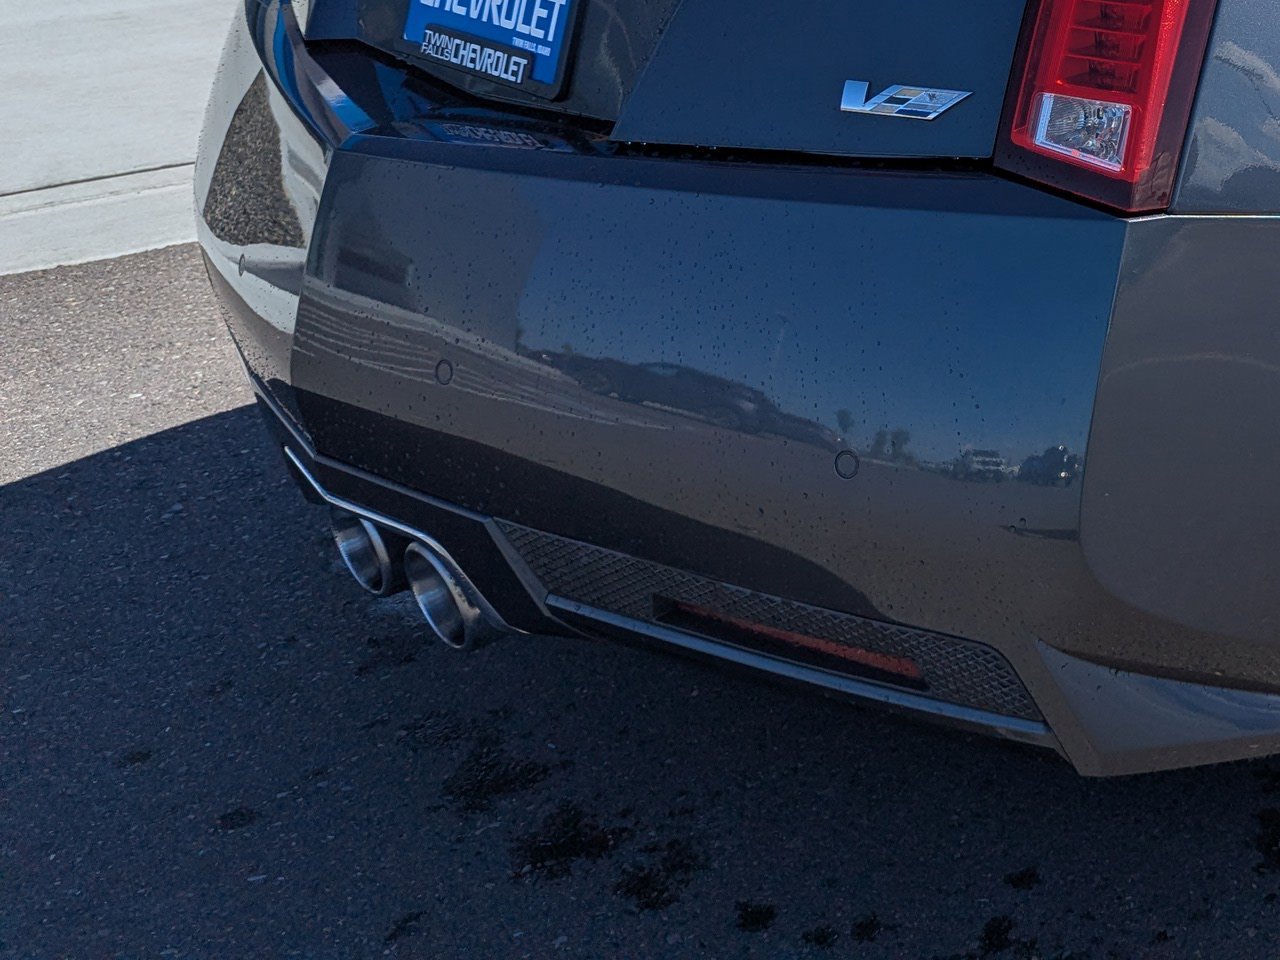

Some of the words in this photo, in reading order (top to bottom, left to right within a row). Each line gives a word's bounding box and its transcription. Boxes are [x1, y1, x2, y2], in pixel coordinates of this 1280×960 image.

[424, 29, 453, 49] TWIN
[421, 42, 451, 61] FALLS
[451, 38, 528, 83] CHEVROLET
